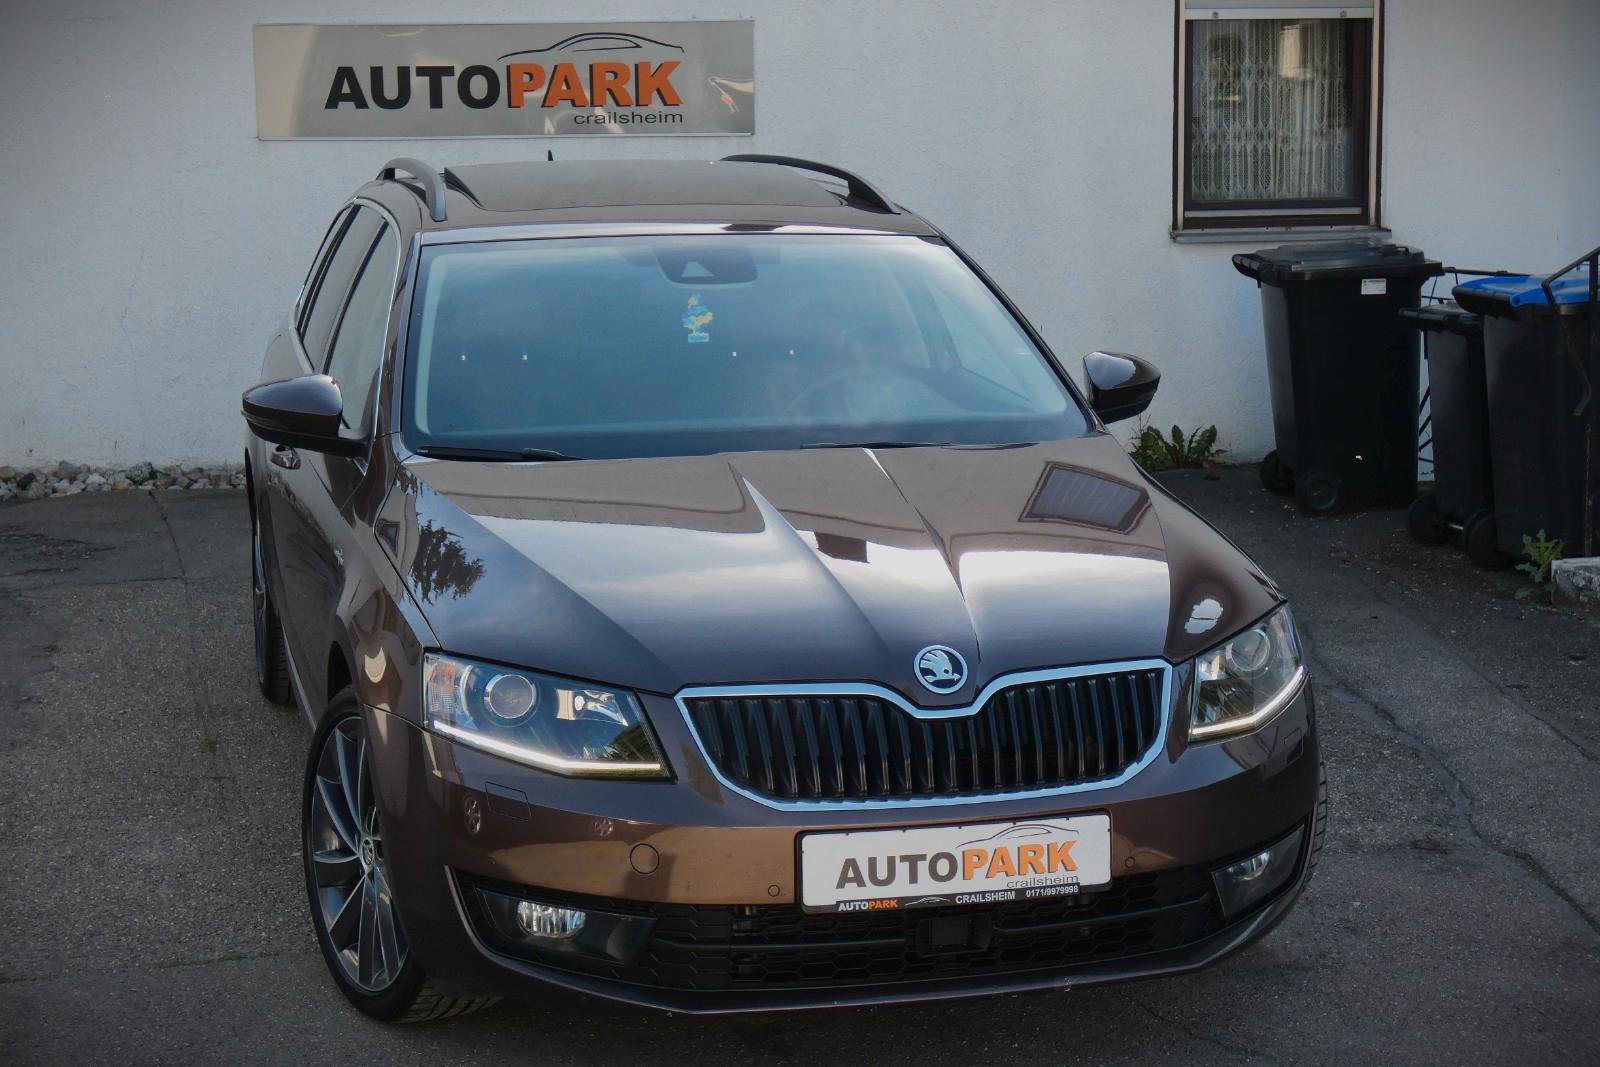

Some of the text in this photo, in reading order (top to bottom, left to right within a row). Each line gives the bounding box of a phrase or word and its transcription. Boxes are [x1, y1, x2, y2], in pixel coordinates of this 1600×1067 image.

[325, 60, 684, 110] AUTOPARK
[573, 109, 684, 125] crailsheim
[835, 840, 1078, 890] AUTOPARK
[1006, 874, 1079, 888] crailsheim
[838, 899, 898, 912] AUTOPARK
[955, 890, 1016, 904] CRAILSHEIM
